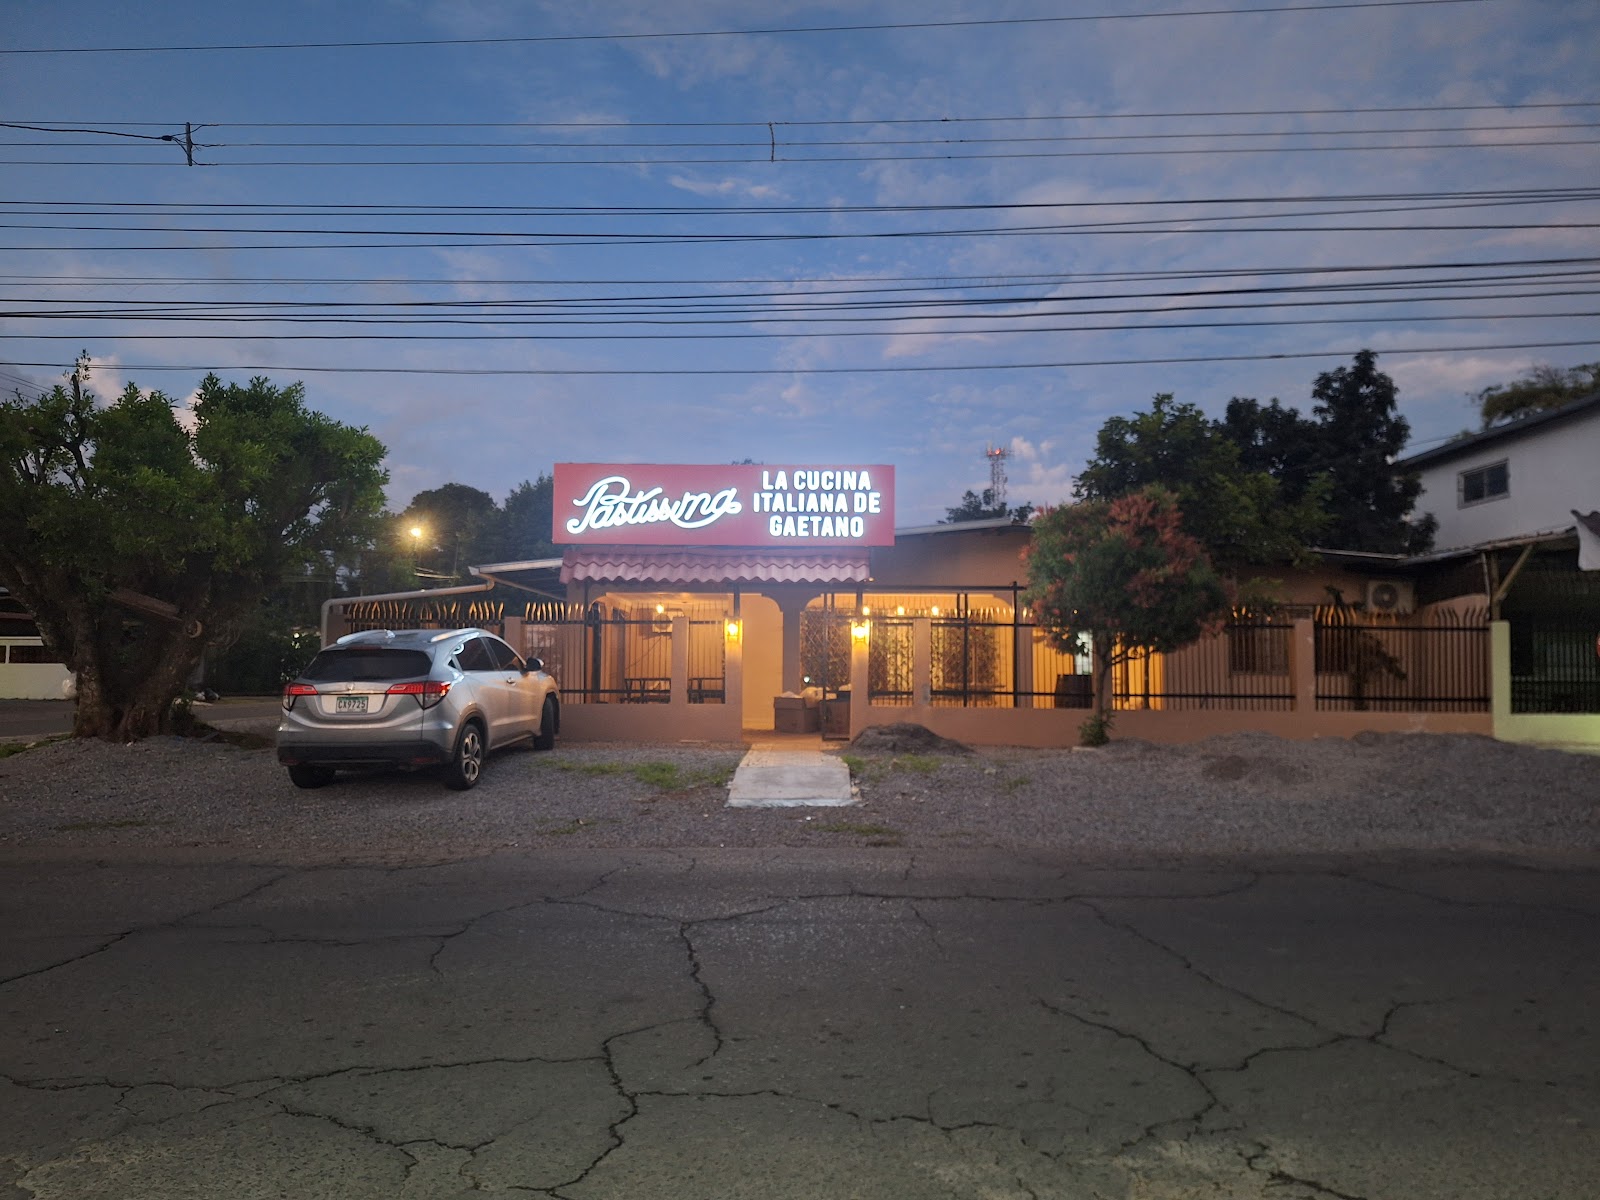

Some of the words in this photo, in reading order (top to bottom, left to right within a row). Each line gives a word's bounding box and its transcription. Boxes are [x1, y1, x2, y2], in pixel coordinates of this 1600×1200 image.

[762, 470, 788, 491] LA
[793, 470, 872, 491] CUCINA
[753, 492, 849, 513] ITALIANA
[853, 492, 881, 514] DE
[769, 515, 864, 537] GAETANO
